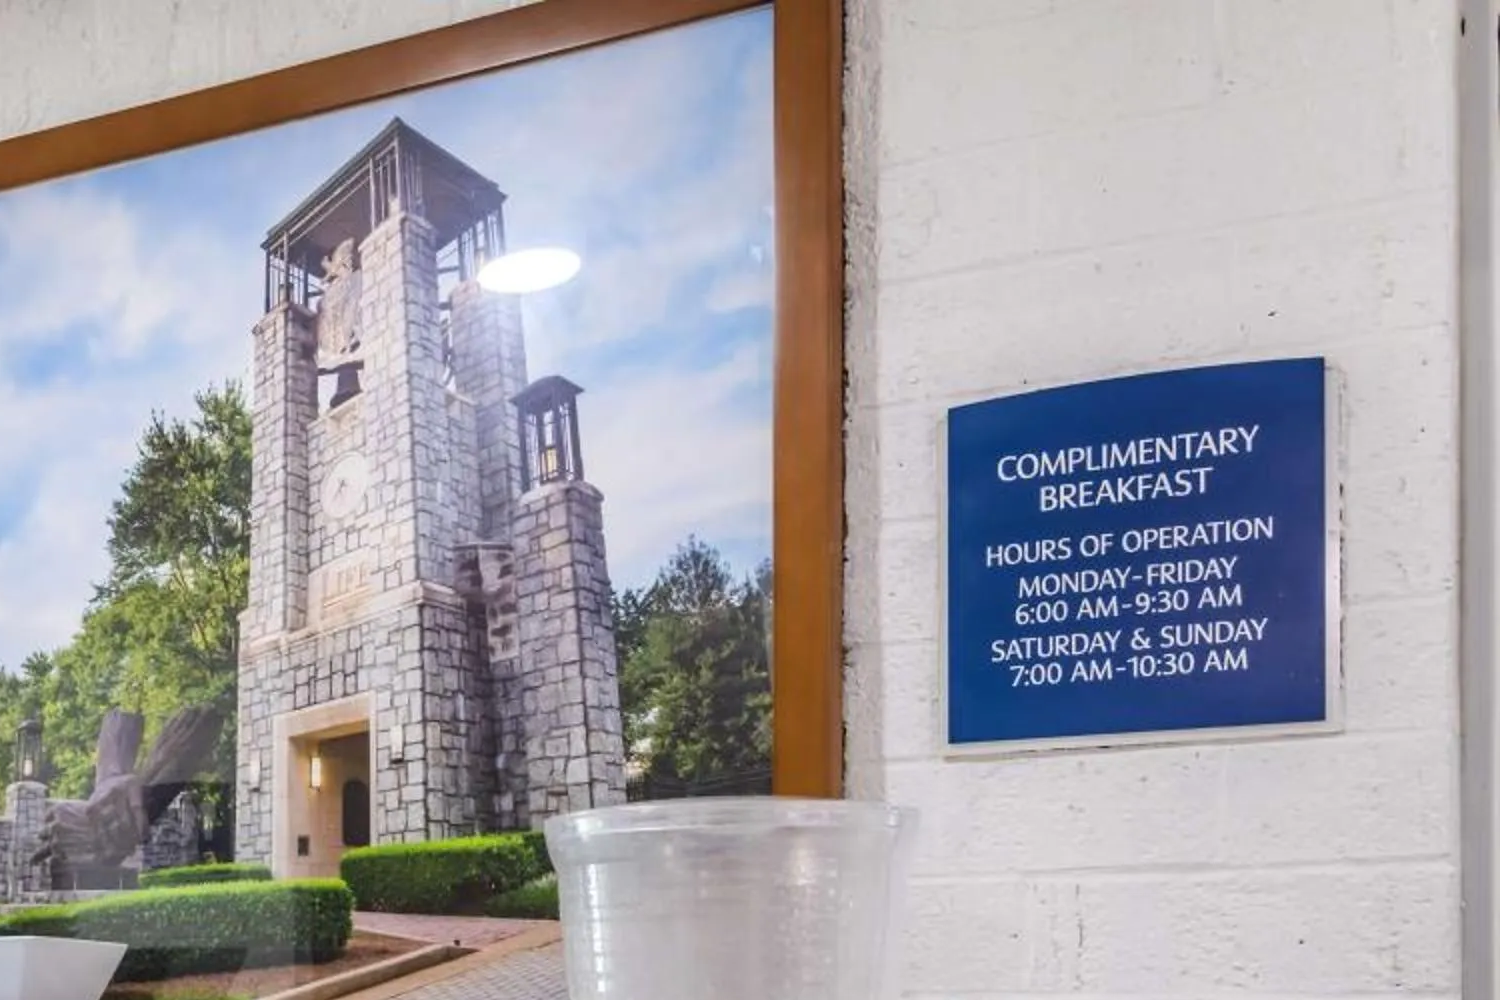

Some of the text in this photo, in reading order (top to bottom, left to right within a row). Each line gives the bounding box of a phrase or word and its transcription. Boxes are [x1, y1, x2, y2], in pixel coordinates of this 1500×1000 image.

[996, 423, 1260, 482] COMPLIMENTARY
[1039, 466, 1214, 512] BREAKFAST
[985, 515, 1274, 567] HOURS OF OPERATION
[1017, 555, 1238, 599] MONDAY-FRIDAY
[1014, 583, 1243, 625] 6:00 AM-9:30 AM
[990, 617, 1269, 663] SATURDAY & SUNDAY
[1008, 647, 1249, 688] 7:00 AM-10:30 AM
